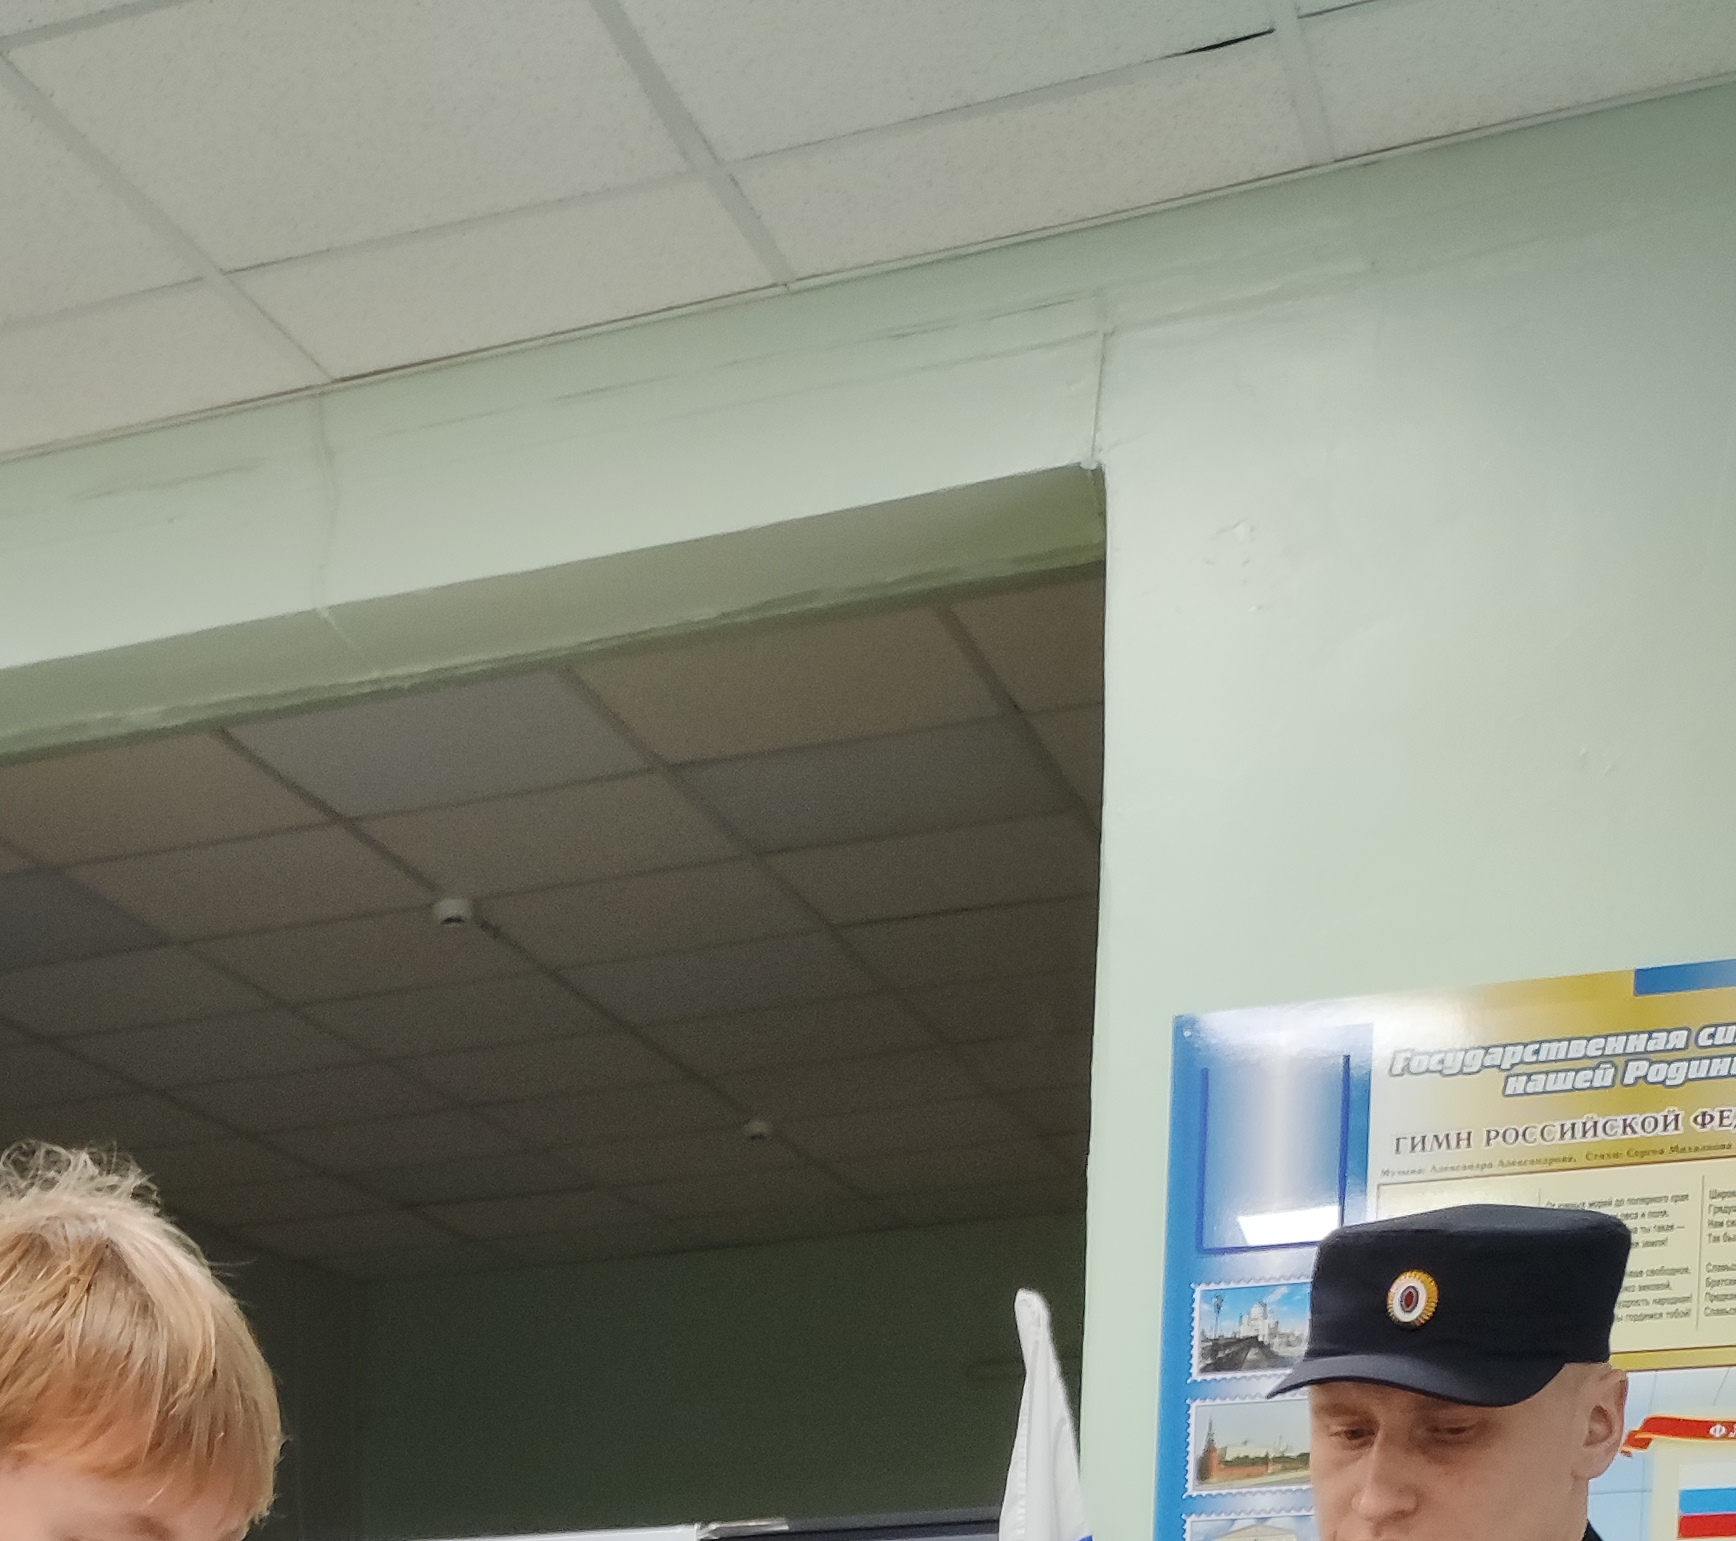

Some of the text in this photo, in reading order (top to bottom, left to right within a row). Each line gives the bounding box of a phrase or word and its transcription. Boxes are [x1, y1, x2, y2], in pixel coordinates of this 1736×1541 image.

[1389, 1023, 1736, 1077] Государственная си
[1504, 1054, 1736, 1097] нашей Родин
[1394, 1109, 1736, 1155] ГИМН РОССИЙСКОЙ ФЕ
